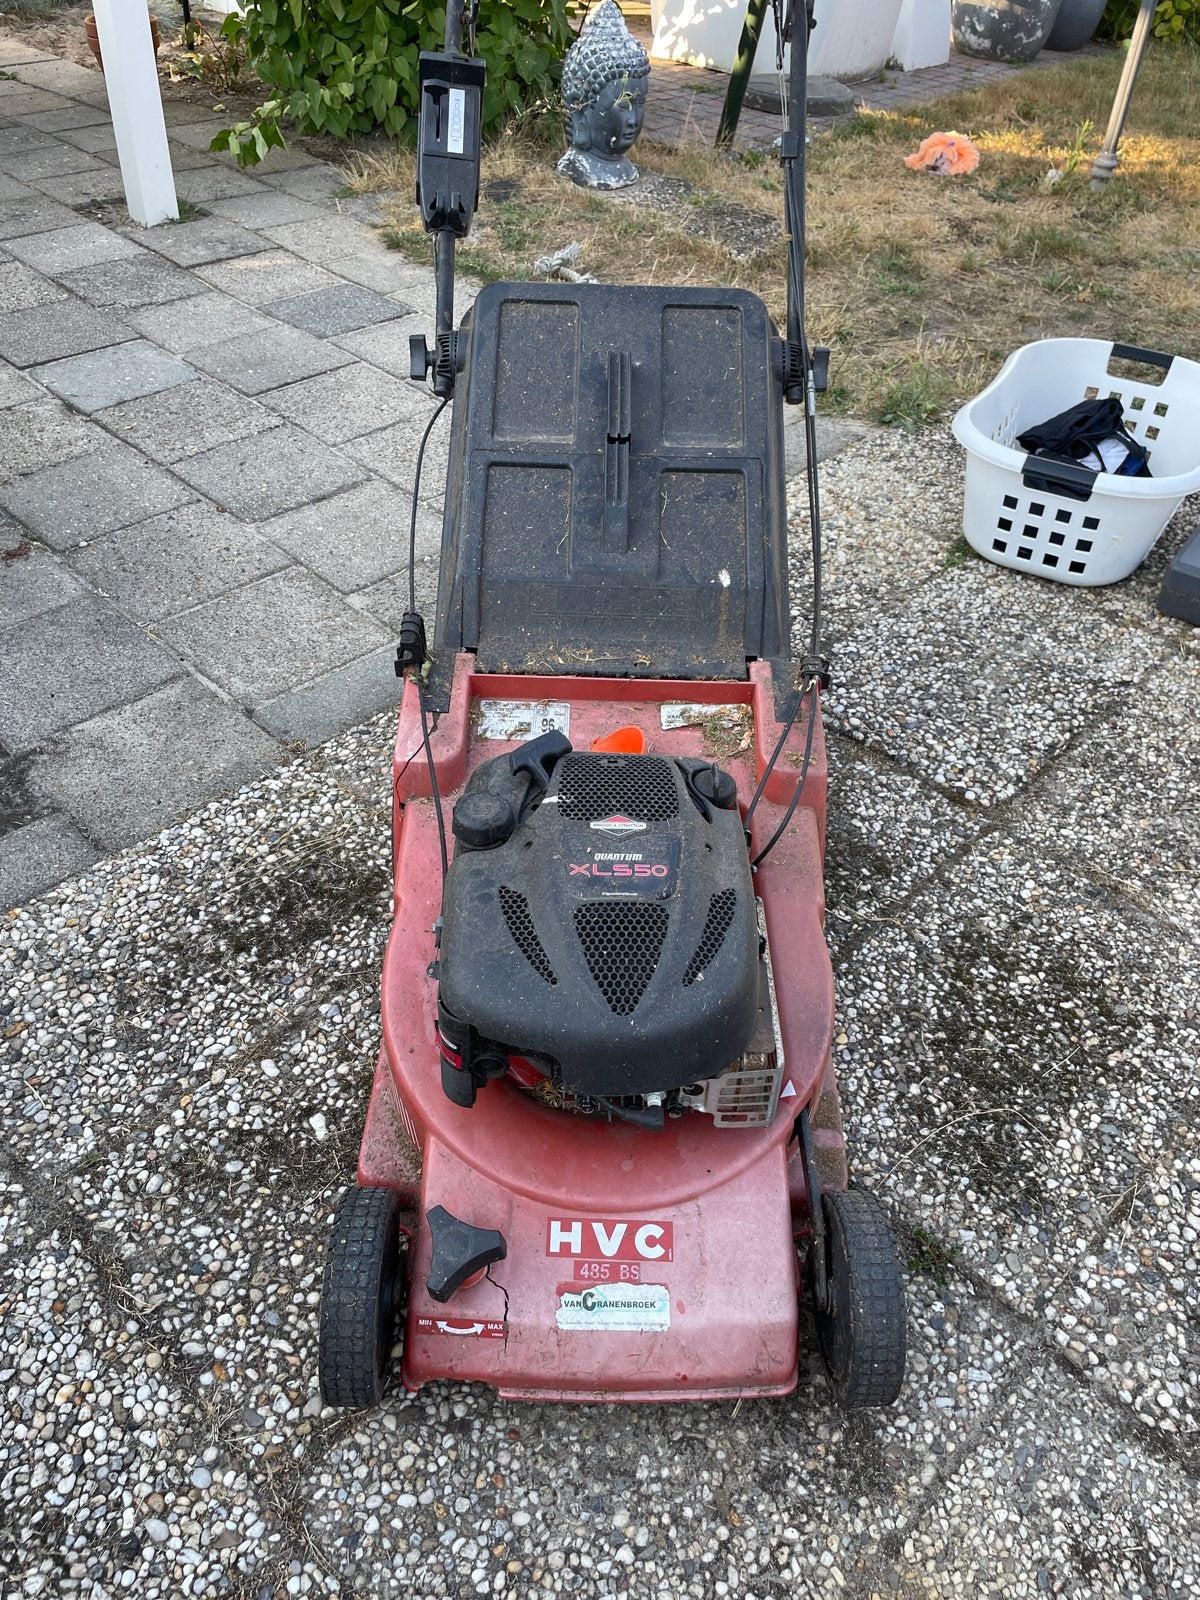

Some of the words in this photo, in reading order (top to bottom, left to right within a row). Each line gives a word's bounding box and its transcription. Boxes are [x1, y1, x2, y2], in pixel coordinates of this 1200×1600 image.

[569, 863, 668, 877] XLS50
[549, 1220, 666, 1259] HVC
[580, 1263, 610, 1279] 485
[619, 1264, 640, 1280] BS
